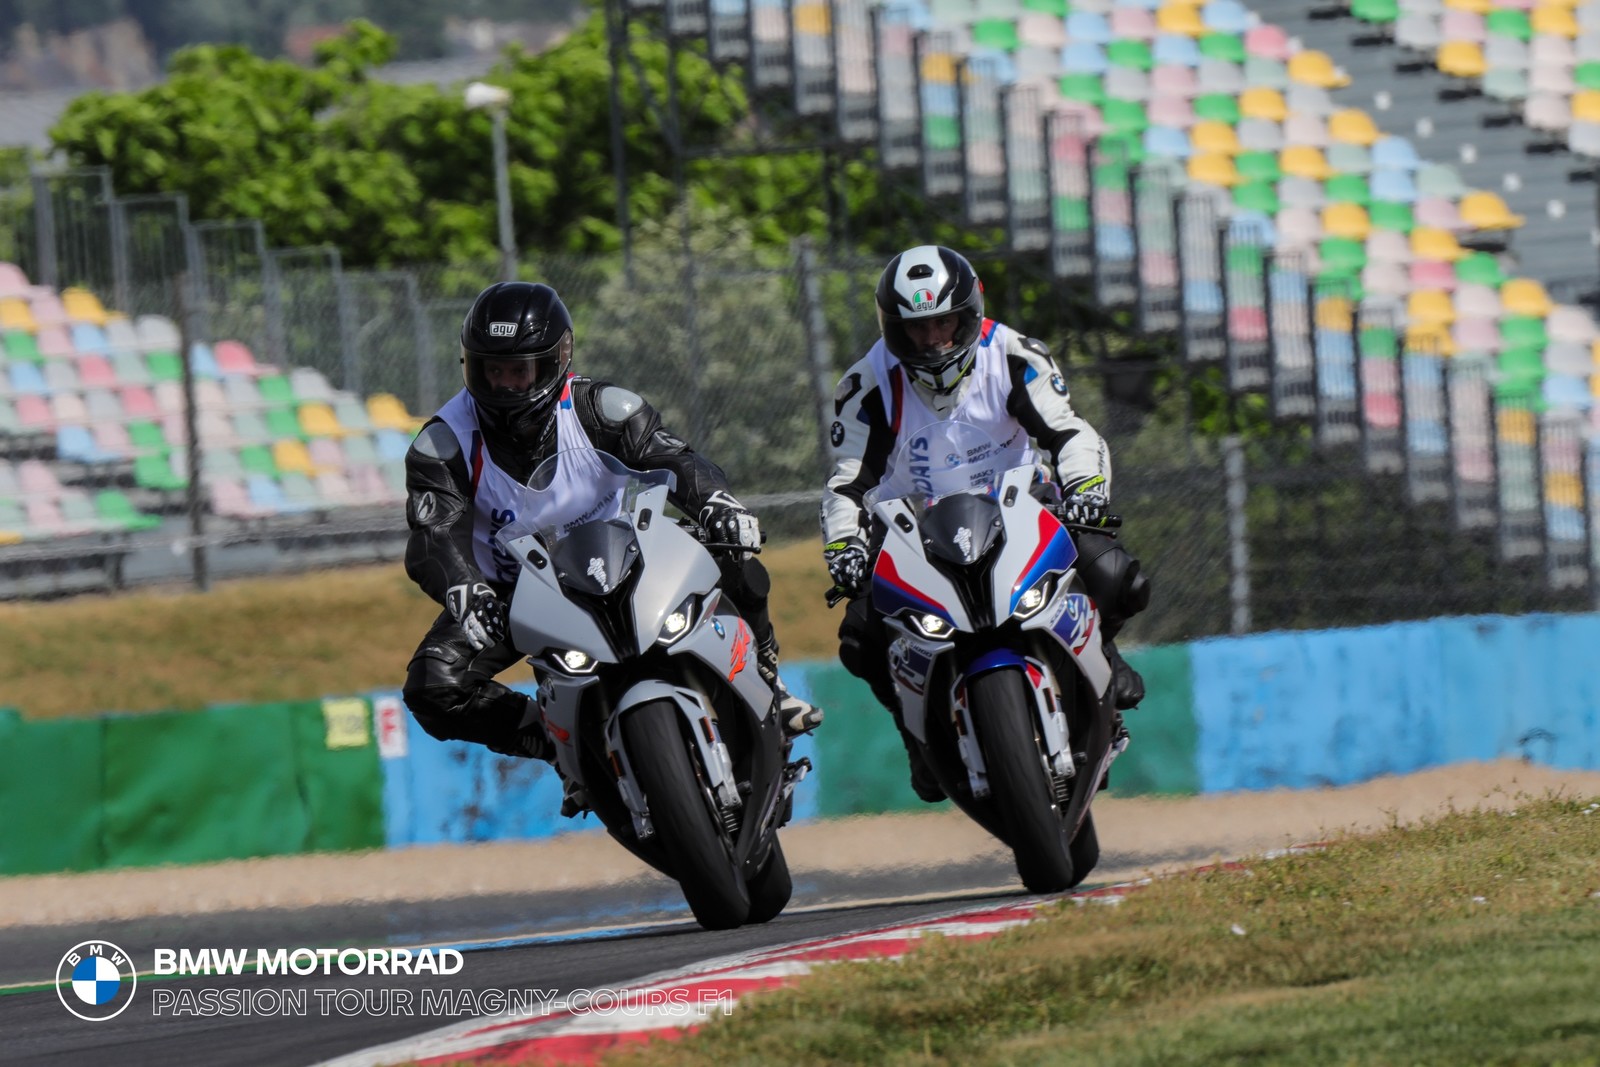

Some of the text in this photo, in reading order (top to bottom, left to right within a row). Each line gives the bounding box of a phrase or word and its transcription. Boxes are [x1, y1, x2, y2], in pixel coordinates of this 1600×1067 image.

[917, 301, 933, 311] agv
[493, 325, 514, 336] agv
[966, 442, 992, 457] BMW
